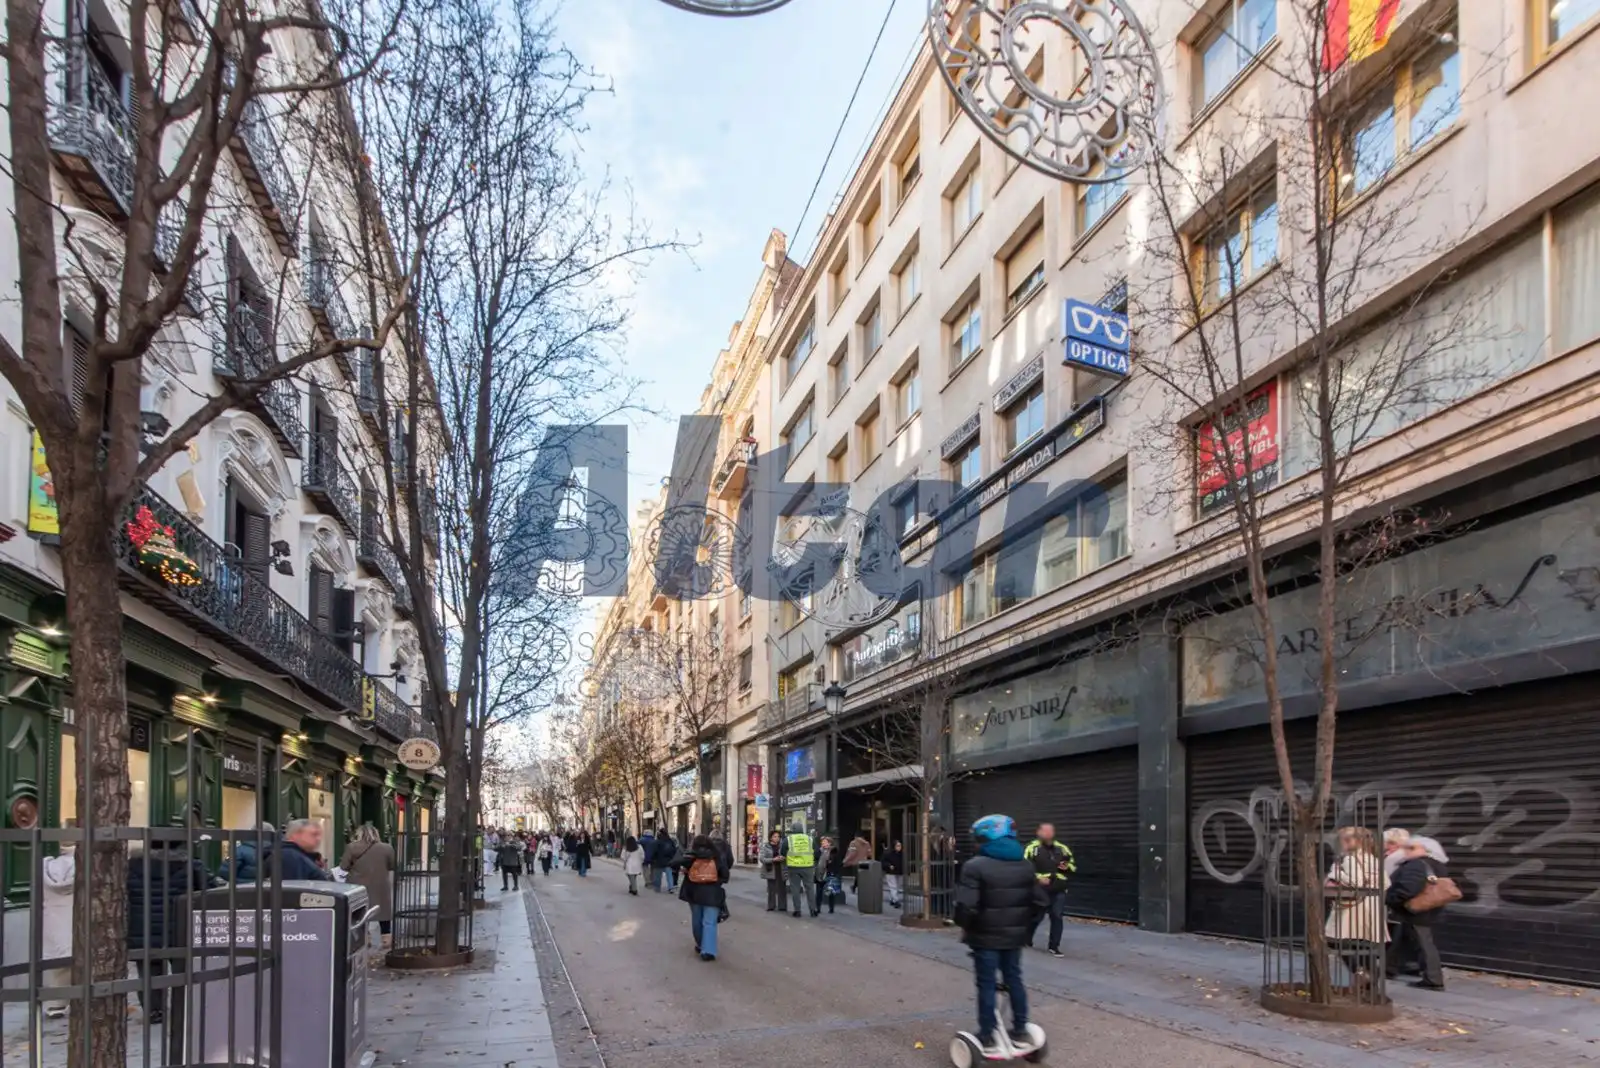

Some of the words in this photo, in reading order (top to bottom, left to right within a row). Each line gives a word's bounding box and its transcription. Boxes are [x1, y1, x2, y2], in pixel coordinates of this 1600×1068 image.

[1071, 341, 1127, 372] OPTICA
[979, 685, 1078, 737] SOUVENIRS
[415, 748, 423, 758] 8
[262, 913, 298, 923] Marid
[194, 933, 244, 944] sencio
[247, 933, 282, 943] etr
[282, 932, 319, 942] todos.
